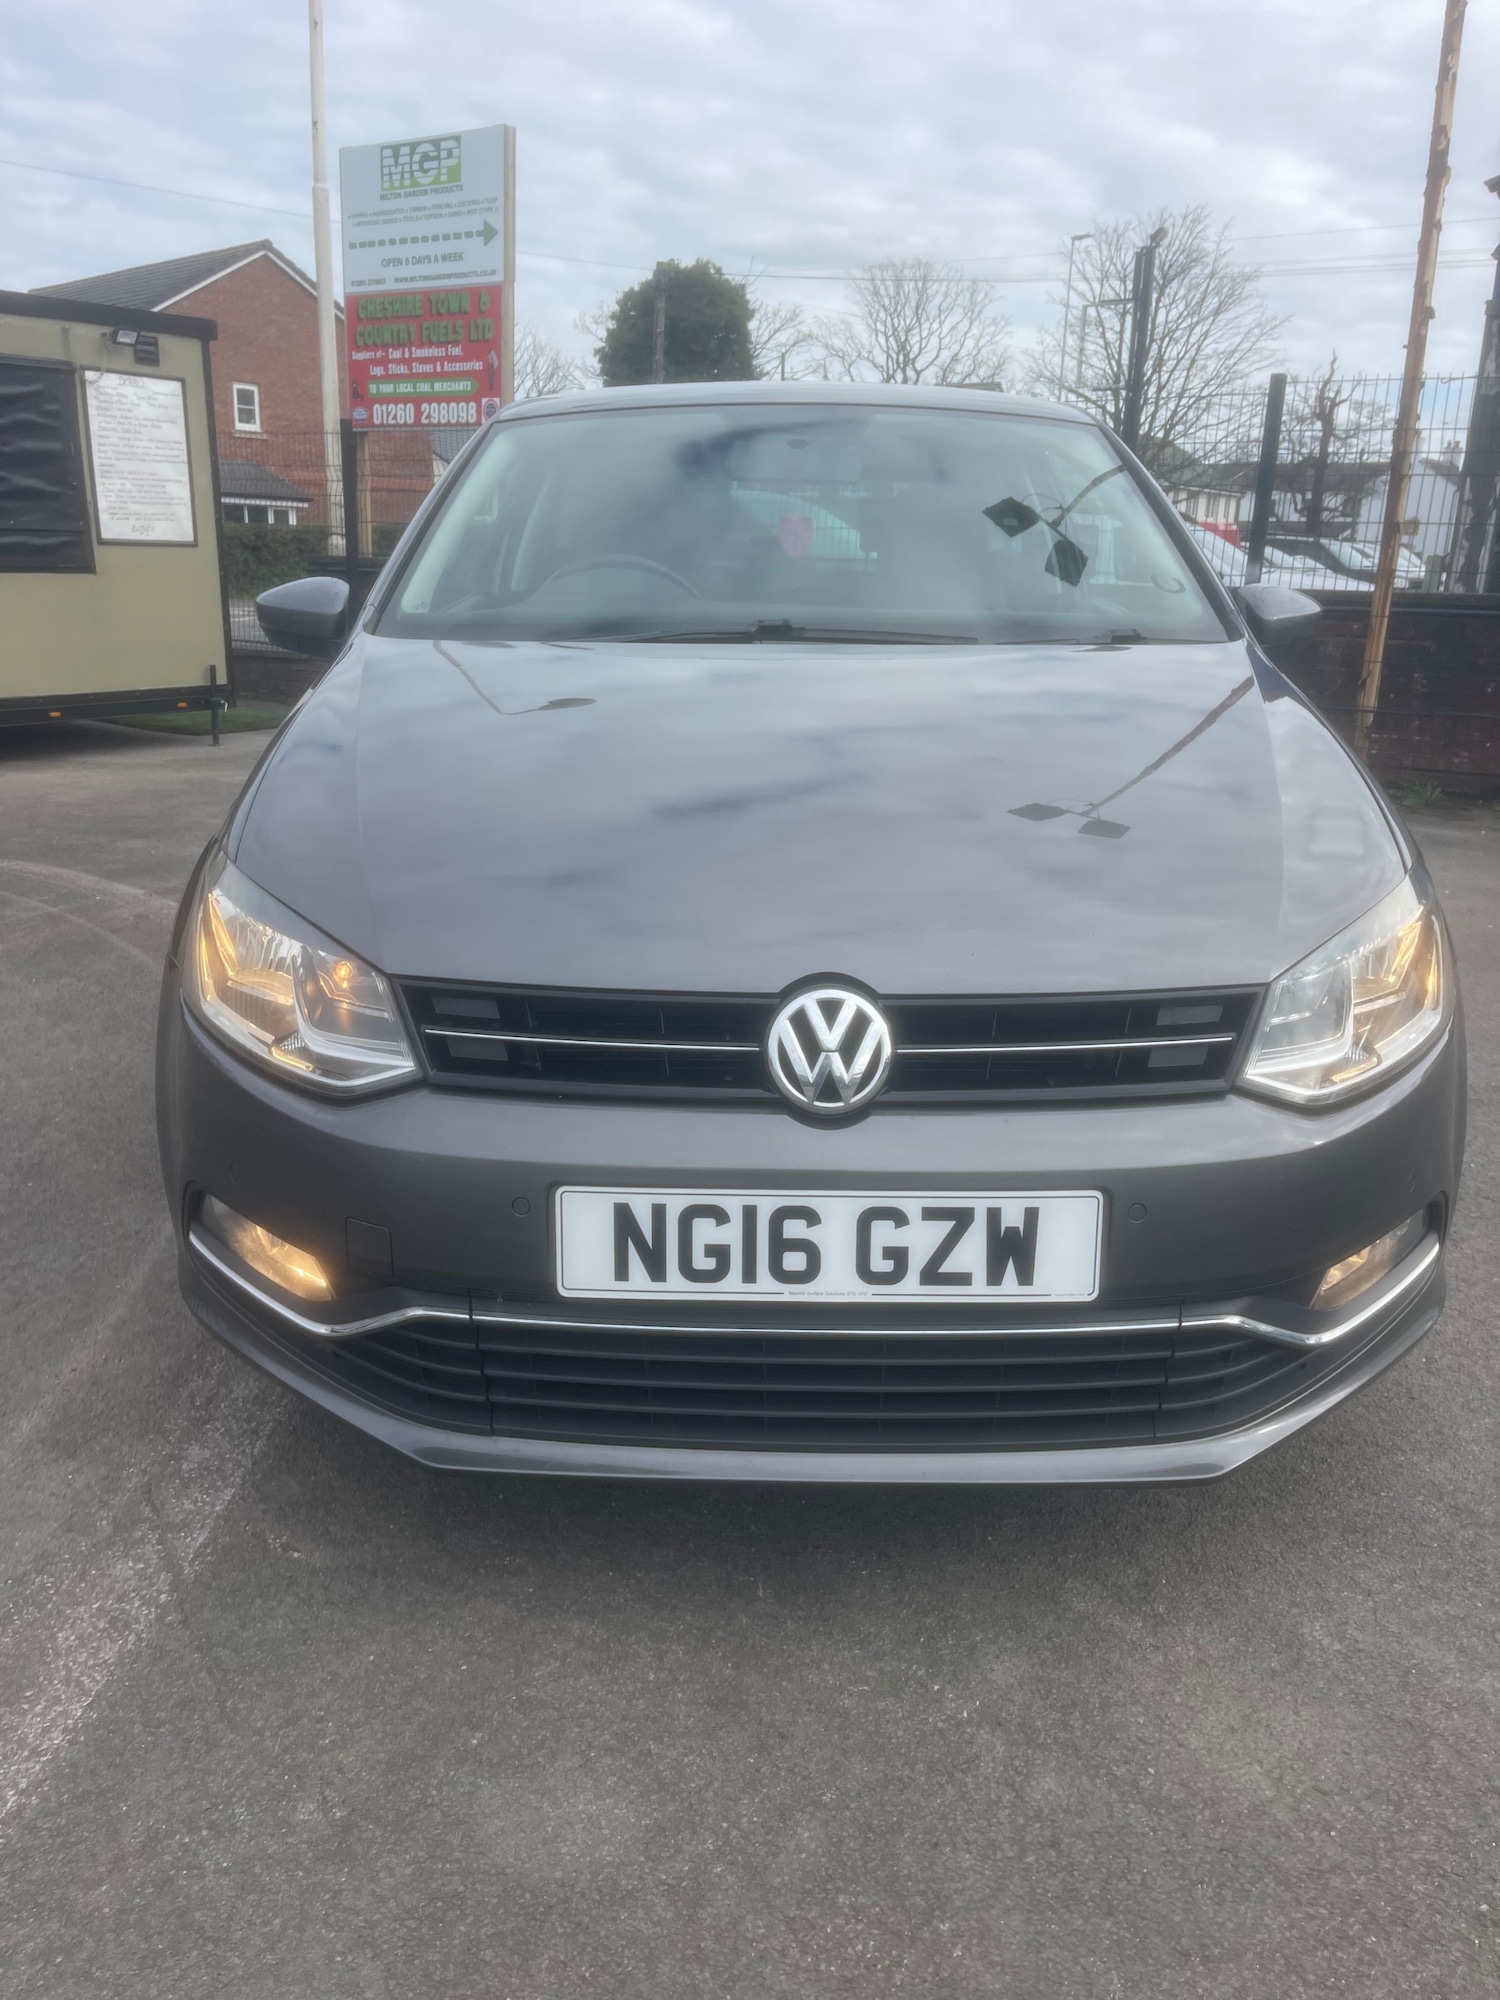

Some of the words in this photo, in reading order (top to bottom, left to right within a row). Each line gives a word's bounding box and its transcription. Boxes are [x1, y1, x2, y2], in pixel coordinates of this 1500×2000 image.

[381, 139, 460, 189] MGP
[403, 188, 429, 198] GARDEN
[430, 184, 463, 195] PRODUCTS
[381, 257, 403, 268] OPEN
[405, 257, 410, 266] 6
[411, 254, 432, 266] DAYS
[433, 254, 439, 263] A
[440, 251, 464, 262] WEEK
[357, 294, 423, 320] CHESHIRE
[428, 291, 470, 316] TOWN
[355, 322, 416, 347] COUNTRY
[420, 319, 464, 343] FUELS
[468, 317, 494, 342] LTD
[352, 350, 375, 361] Suppliers
[388, 348, 402, 359] Coal
[404, 347, 410, 359] &
[411, 346, 445, 358] Smokeless
[412, 362, 434, 374] Stoves
[436, 361, 441, 372] &
[443, 359, 484, 372] Accessories
[369, 384, 377, 394] TO
[379, 383, 394, 393] YOUR
[396, 382, 415, 393] LOCAL
[416, 381, 432, 392] COAL
[434, 380, 472, 392] MERCHANTS
[373, 403, 415, 425] 01260
[420, 401, 477, 424] 298098
[613, 1202, 822, 1285] NG16
[855, 1206, 1040, 1287] GZW
